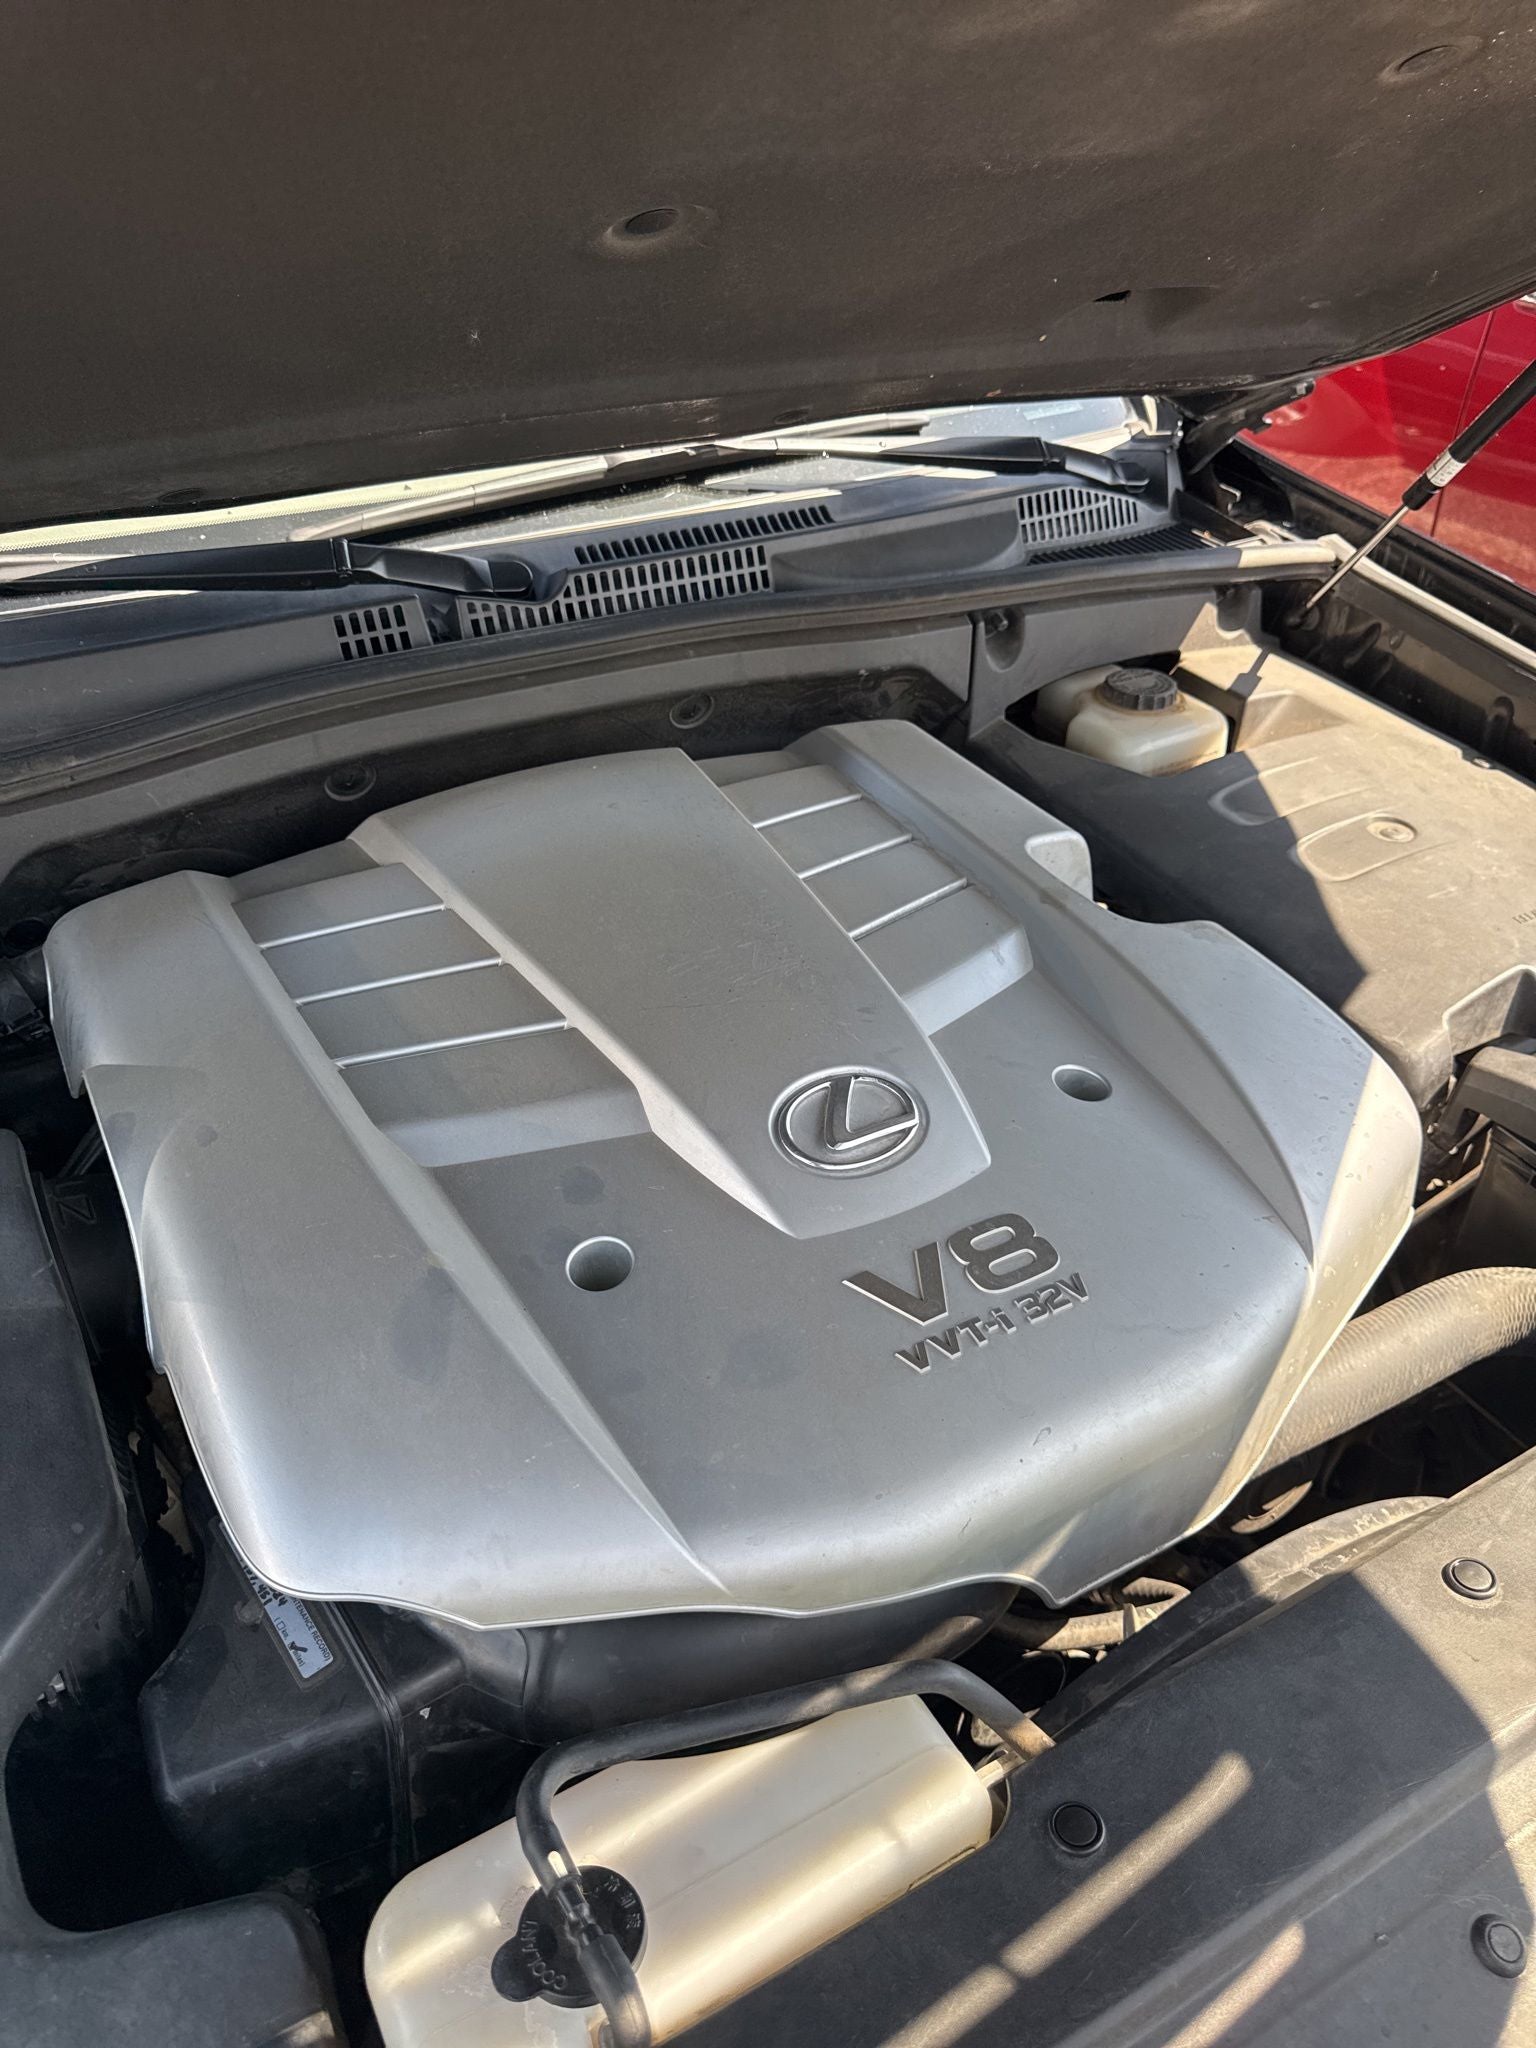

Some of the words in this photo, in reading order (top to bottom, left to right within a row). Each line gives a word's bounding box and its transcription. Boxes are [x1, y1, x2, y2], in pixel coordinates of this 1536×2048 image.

[842, 1213, 1060, 1326] V8
[895, 1307, 1018, 1374] VVT-i
[1014, 1272, 1090, 1325] 32V
